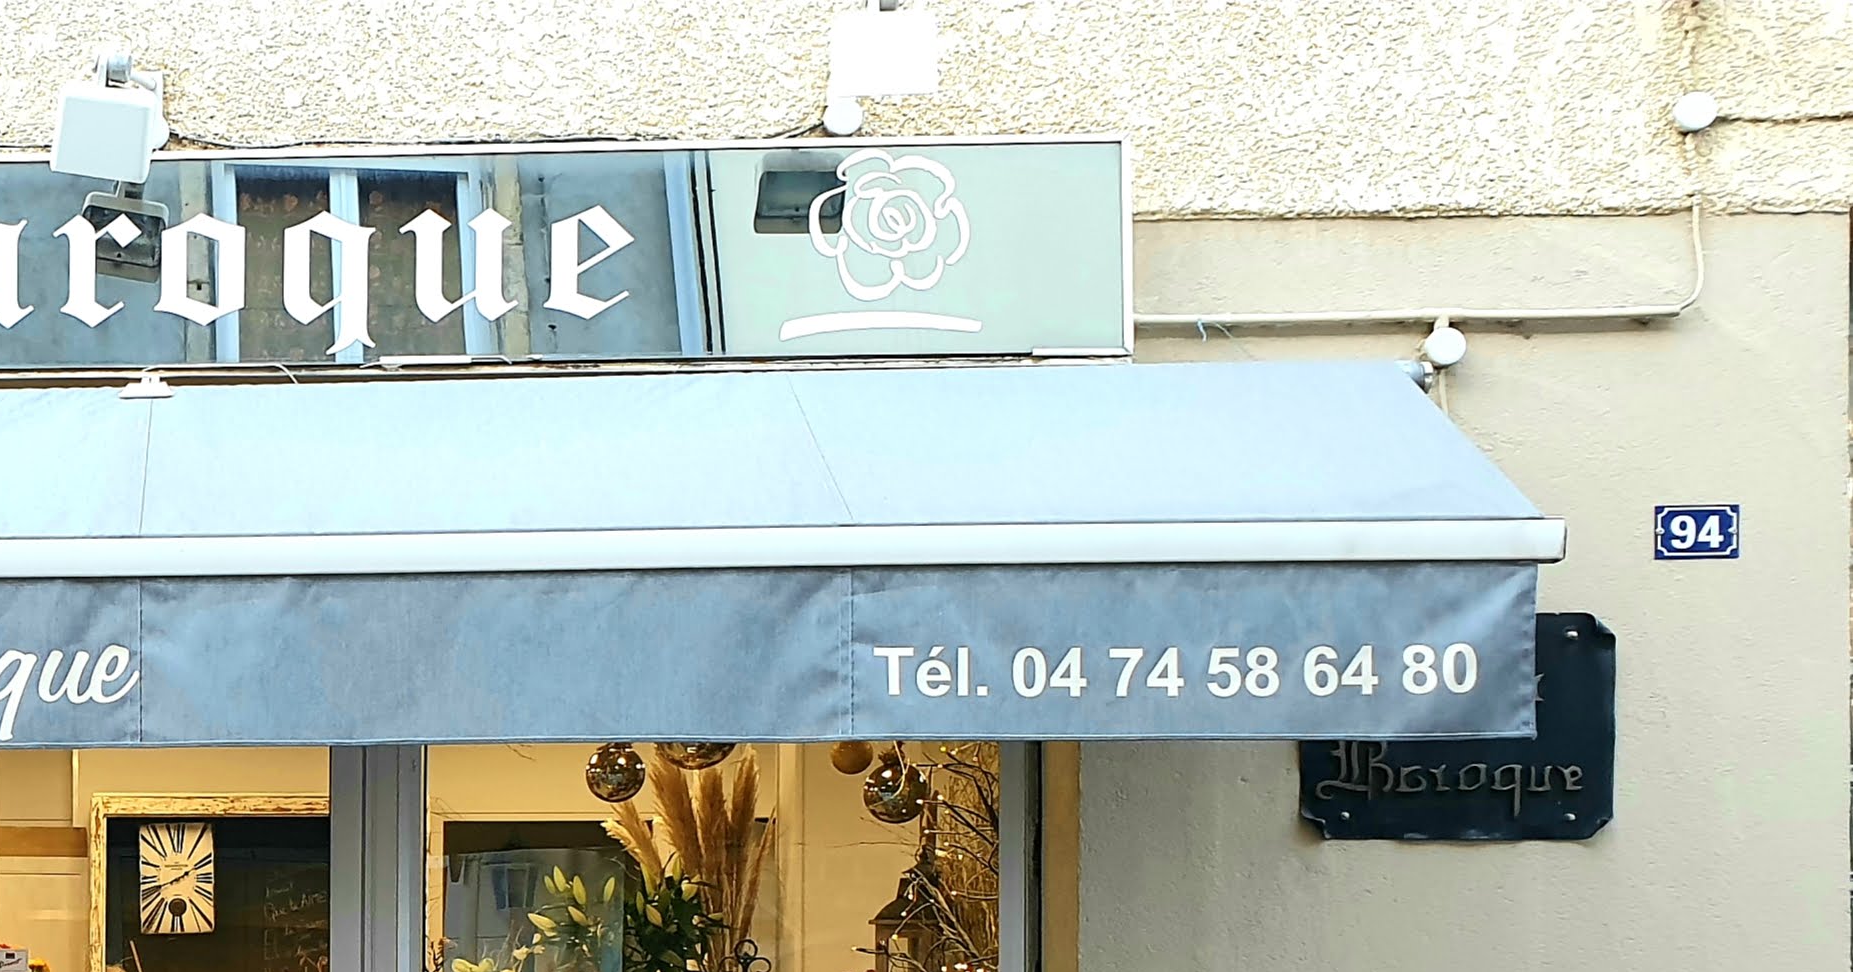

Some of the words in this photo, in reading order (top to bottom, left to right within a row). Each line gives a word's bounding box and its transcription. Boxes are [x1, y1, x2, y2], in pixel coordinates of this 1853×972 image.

[1670, 514, 1724, 549] 94
[873, 645, 988, 697] Tél.
[1011, 646, 1088, 698] 04
[1108, 646, 1185, 698] 74
[1206, 646, 1280, 698] 58
[1304, 645, 1379, 697] 64
[1401, 643, 1479, 695] 80
[1315, 740, 1584, 817] Baroque
